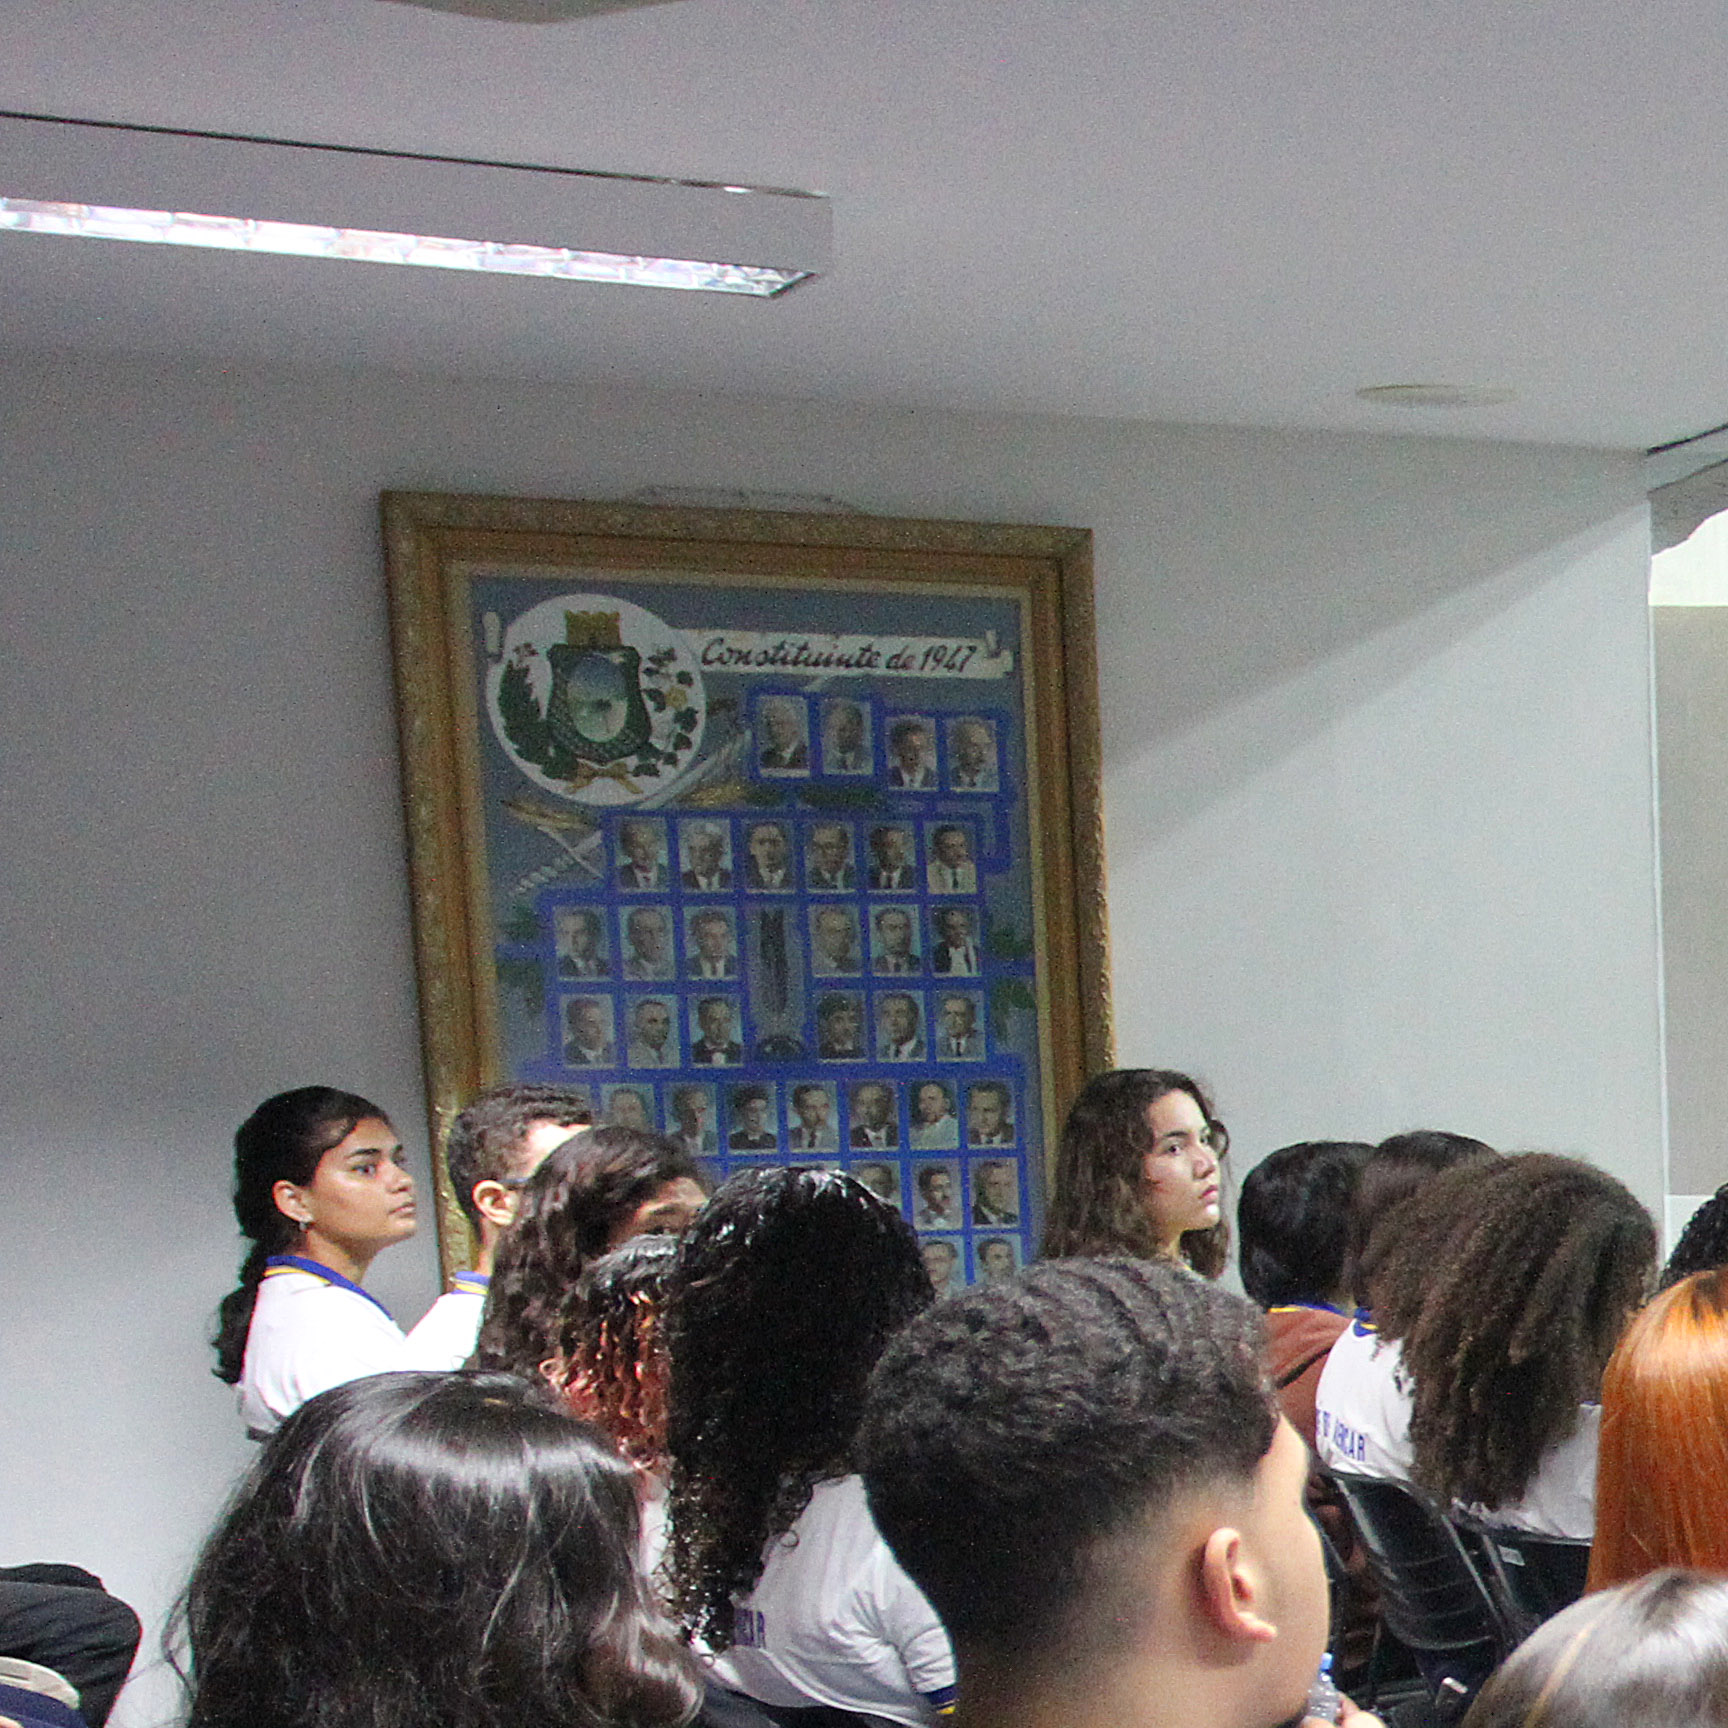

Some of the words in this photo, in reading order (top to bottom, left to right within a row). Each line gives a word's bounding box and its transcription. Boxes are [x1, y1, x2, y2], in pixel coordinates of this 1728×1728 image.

[701, 637, 881, 669] Constituinte
[885, 648, 915, 671] de
[920, 644, 977, 673] 1947
